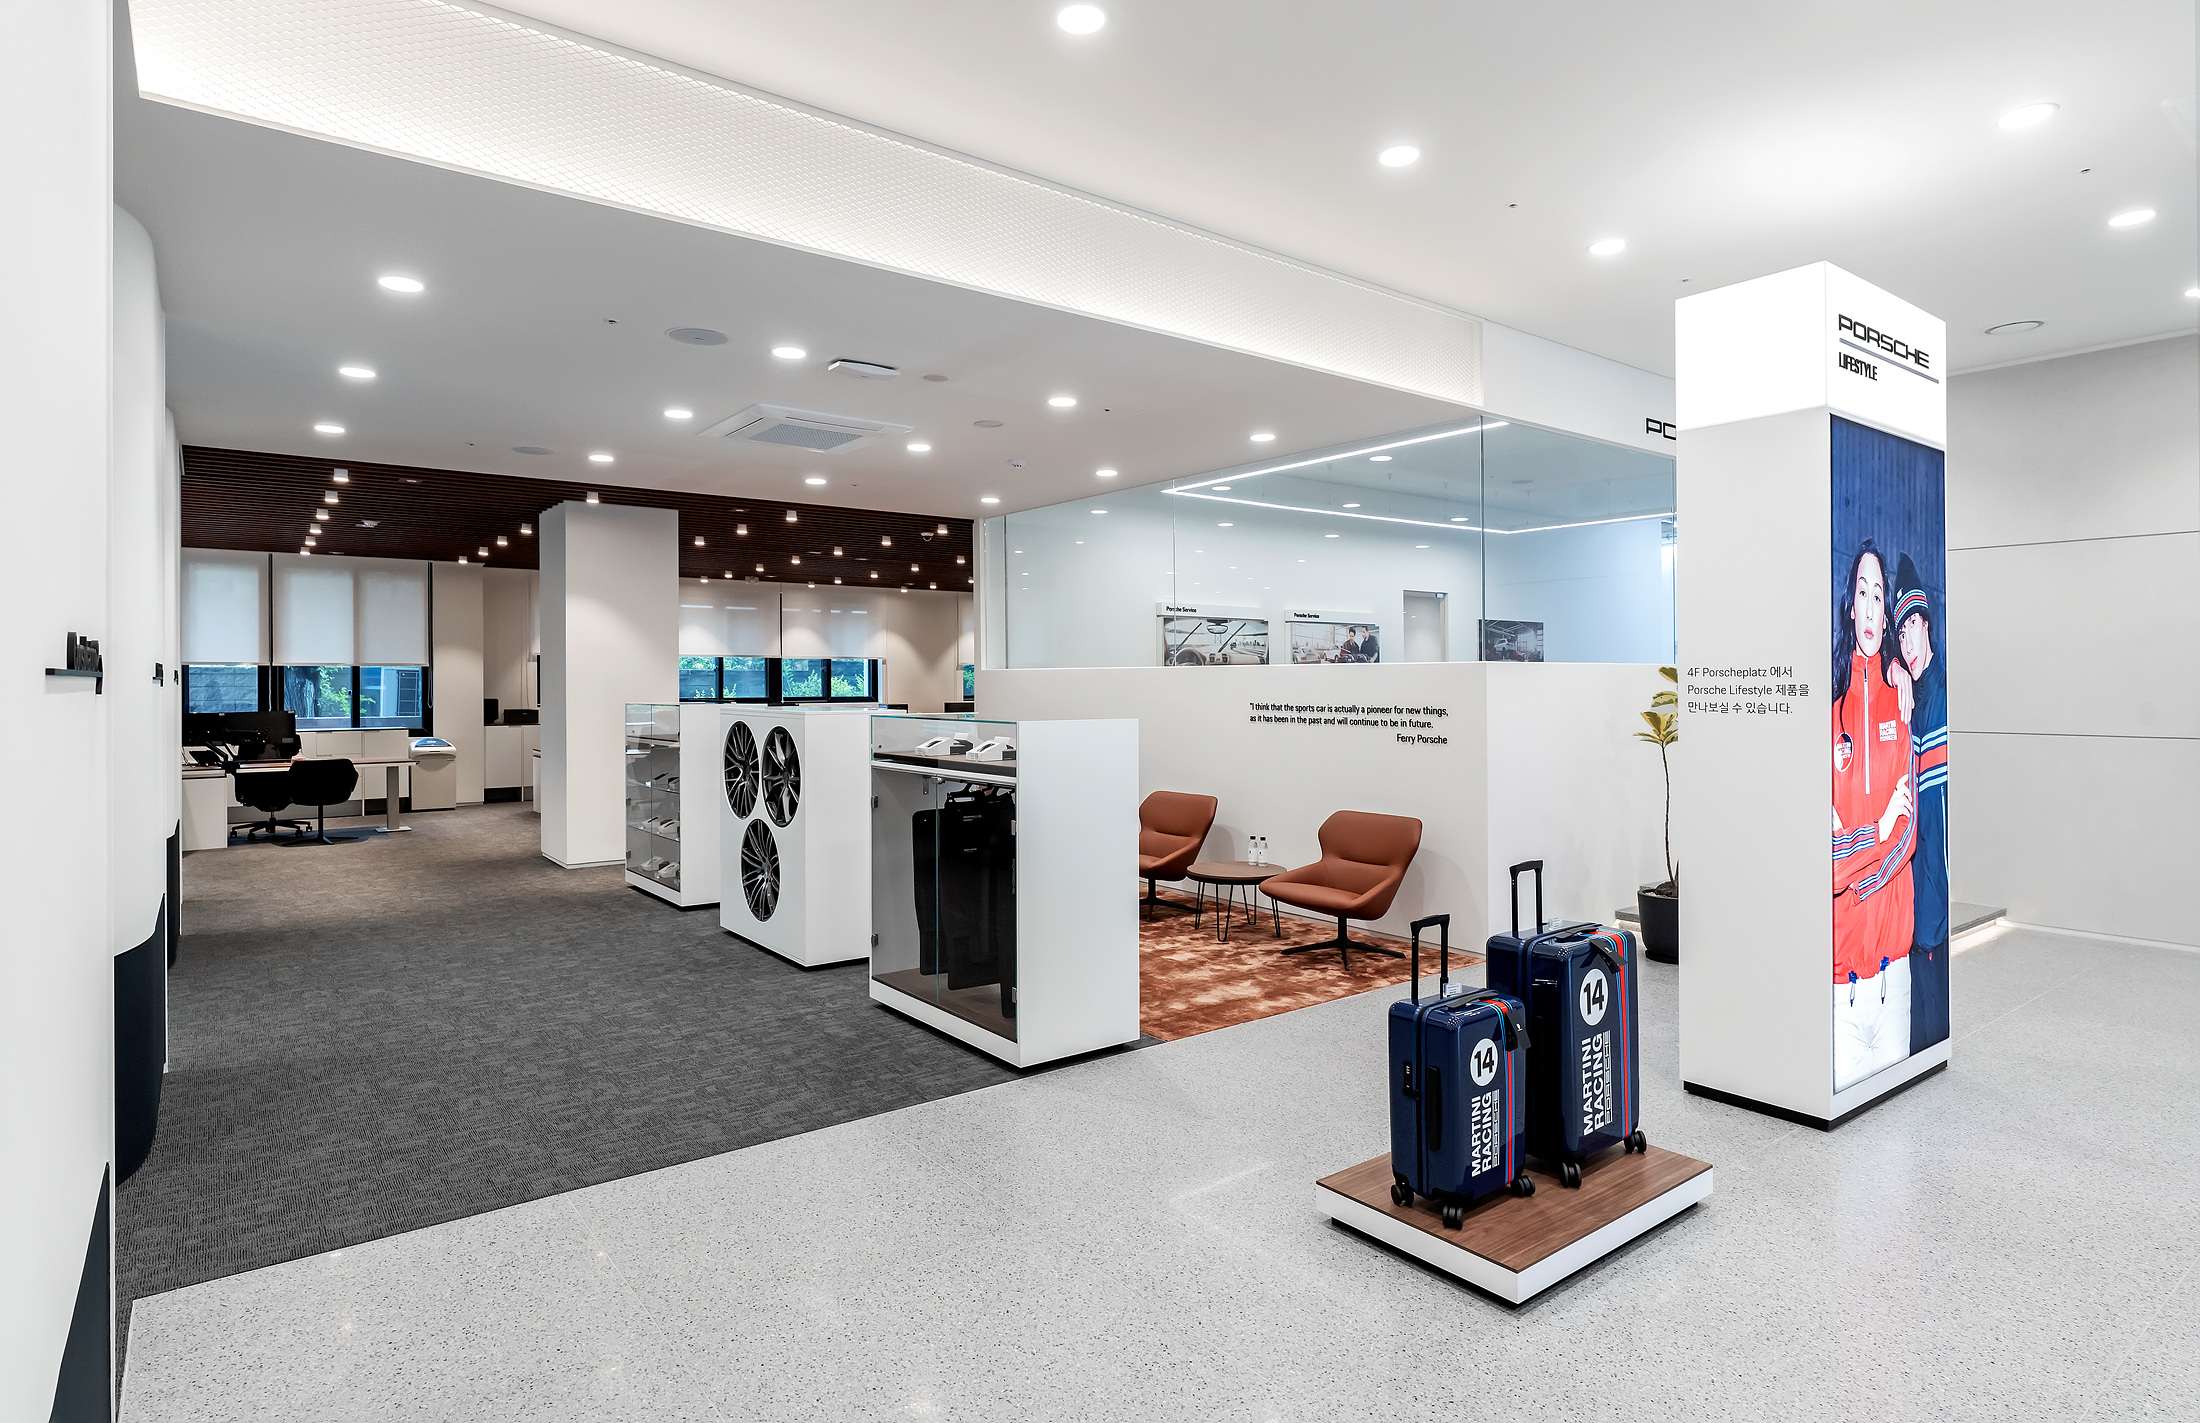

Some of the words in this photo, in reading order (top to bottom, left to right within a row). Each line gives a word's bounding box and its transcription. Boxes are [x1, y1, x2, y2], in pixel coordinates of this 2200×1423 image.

[1838, 313, 1930, 370] PORSCHE
[1838, 351, 1878, 381] LIFESTYLE
[1165, 605, 1182, 613] Porche
[1687, 667, 1700, 677] 4F
[1702, 666, 1768, 680] Porscheplatz
[1769, 665, 1793, 678] 에서
[1687, 684, 1727, 695] Porsche
[1729, 684, 1773, 697] Lifestyle
[1775, 683, 1810, 697] 제품을
[1255, 702, 1269, 711] think
[1270, 702, 1283, 711] that
[1284, 703, 1294, 711] the
[1295, 704, 1314, 713] sports
[1327, 703, 1333, 712] is
[1334, 705, 1360, 715] actually
[1366, 705, 1392, 715] pioneer
[1394, 705, 1404, 714] for
[1405, 707, 1421, 715] new
[1422, 706, 1448, 717] things,
[1257, 714, 1262, 722] it
[1263, 714, 1273, 722] has
[1274, 715, 1288, 723] been
[1290, 715, 1295, 723] in
[1297, 715, 1307, 724] the
[1308, 716, 1322, 725] past
[1323, 716, 1335, 725] and
[1336, 716, 1348, 725] will
[1349, 717, 1379, 727] continue
[1380, 718, 1388, 727] to
[1389, 718, 1398, 727] be
[1400, 718, 1407, 727] in
[1409, 718, 1434, 728] future.
[1687, 701, 1729, 714] 만나보실
[1731, 702, 1743, 714] 수
[1745, 702, 1793, 715] 있습니다.
[1396, 733, 1415, 745] Ferry
[1417, 734, 1448, 745] Porsche
[1583, 978, 1604, 1016] 14
[1474, 1046, 1495, 1078] 14
[1581, 1037, 1594, 1136] MARTINI
[1592, 1032, 1605, 1130] RACING
[1471, 1095, 1481, 1178] MARTINI
[1482, 1091, 1492, 1173] RACING
